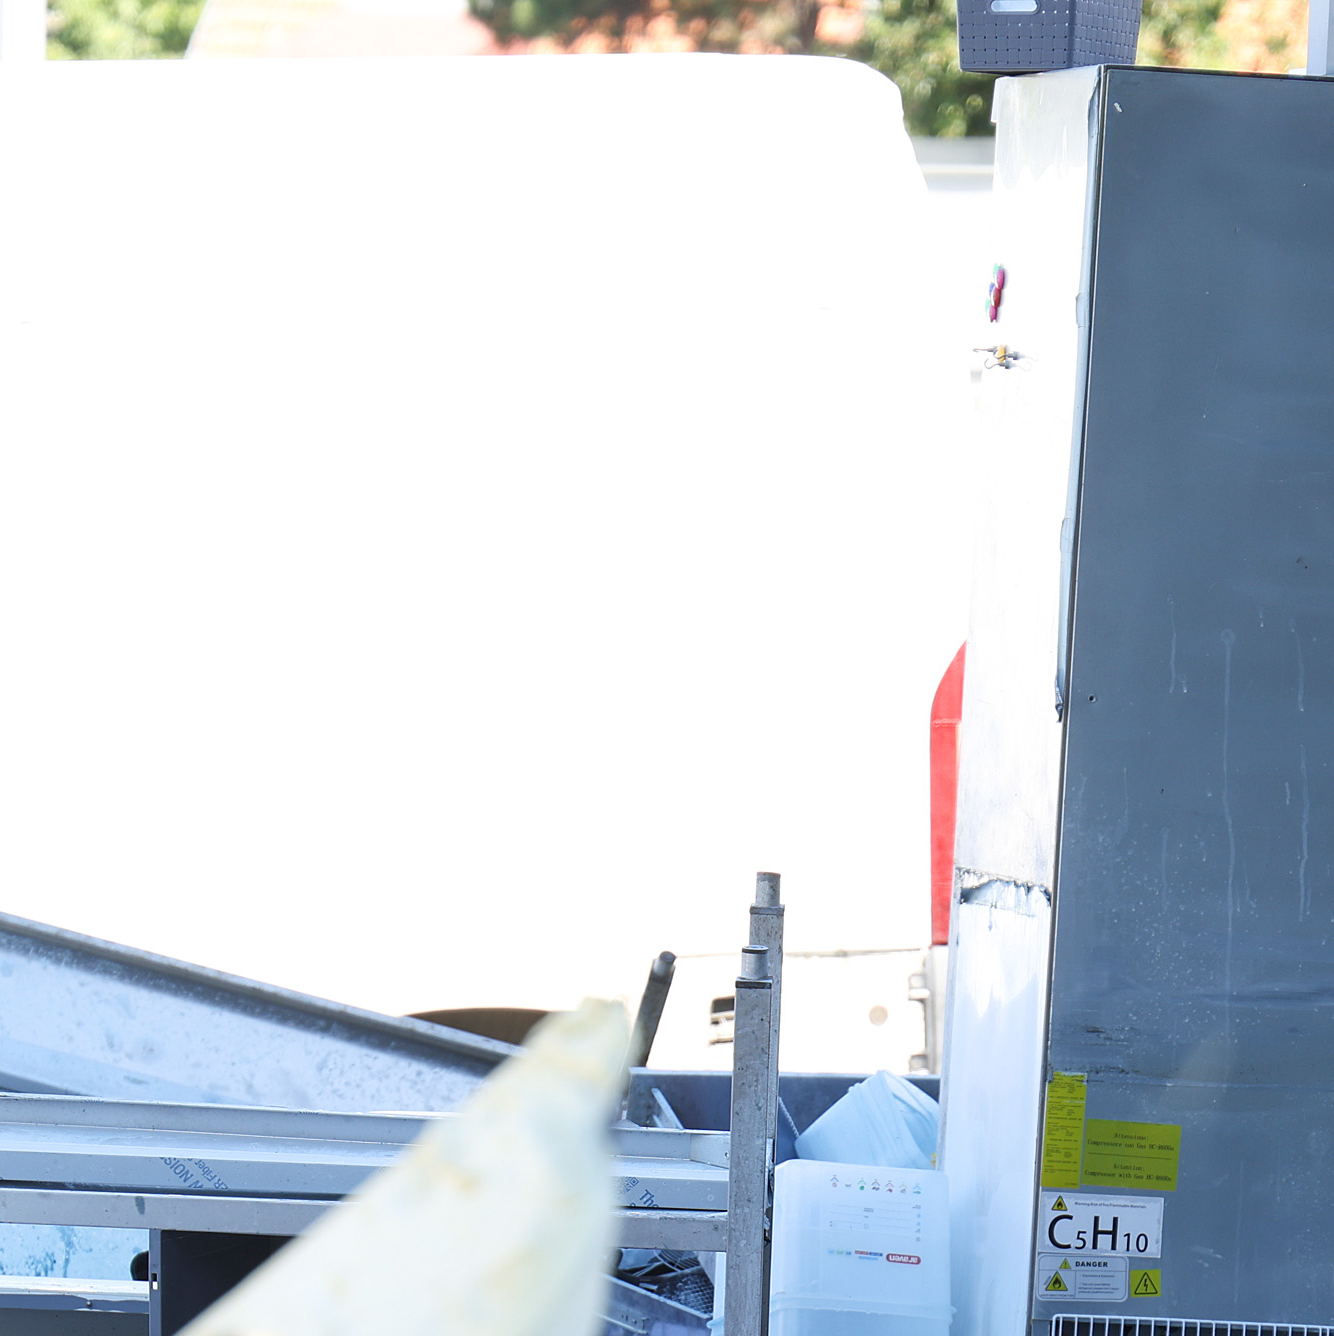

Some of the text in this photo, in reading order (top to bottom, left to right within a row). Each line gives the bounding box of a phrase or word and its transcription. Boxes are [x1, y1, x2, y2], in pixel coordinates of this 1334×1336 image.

[159, 1156, 194, 1184] NOIS
[194, 1157, 222, 1183] Fiber
[889, 1254, 919, 1263] araven
[1075, 1260, 1109, 1268] DANGER
